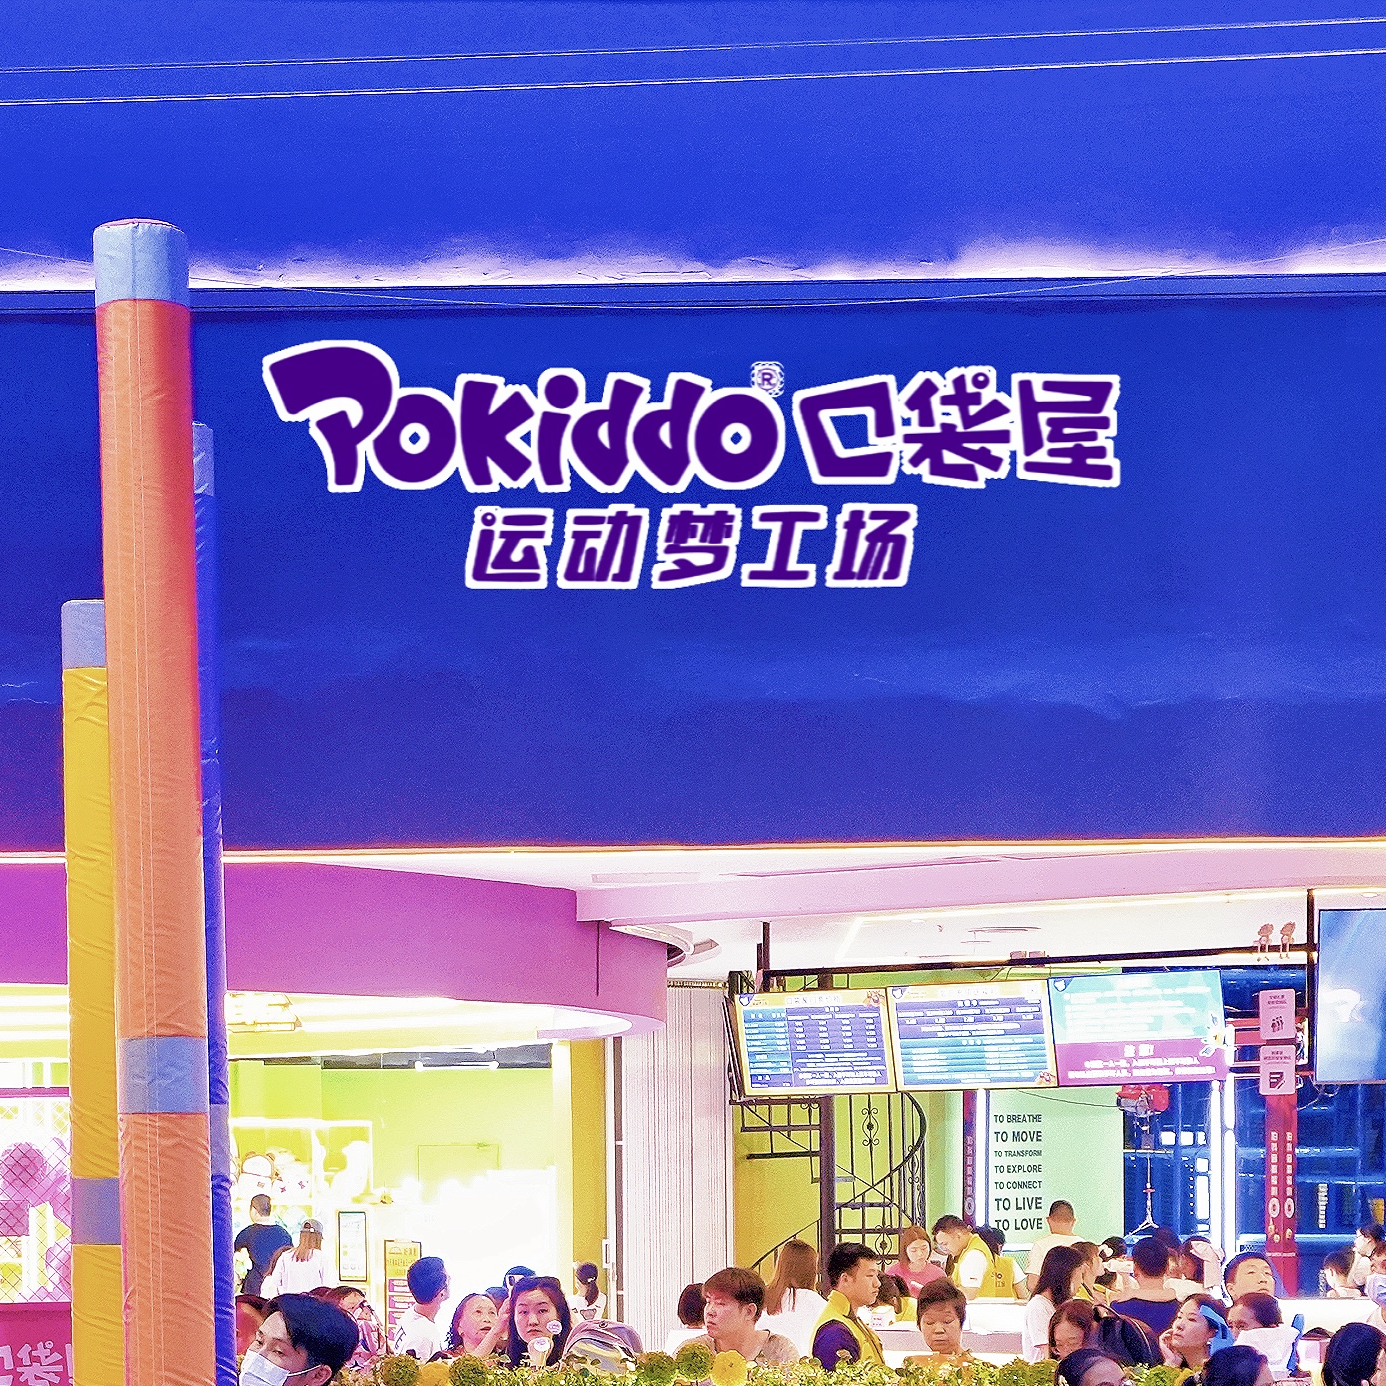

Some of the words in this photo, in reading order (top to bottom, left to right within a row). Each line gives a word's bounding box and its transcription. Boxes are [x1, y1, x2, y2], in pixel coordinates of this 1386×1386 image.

[793, 366, 1121, 487] 口袋屋
[465, 504, 918, 588] 运动梦工场
[994, 1114, 1004, 1123] TO
[1007, 1114, 1043, 1123] BREATHE
[994, 1131, 1008, 1142] TO
[1012, 1131, 1043, 1142] MOVE
[994, 1164, 1004, 1173] TO
[1007, 1164, 1043, 1173] EXPLORE
[994, 1180, 1004, 1189] TO
[1006, 1180, 1043, 1189] CONNECT
[994, 1197, 1011, 1211] TO
[1015, 1197, 1043, 1211] LIVE
[994, 1218, 1010, 1231] TO
[1014, 1218, 1043, 1231] LOVE
